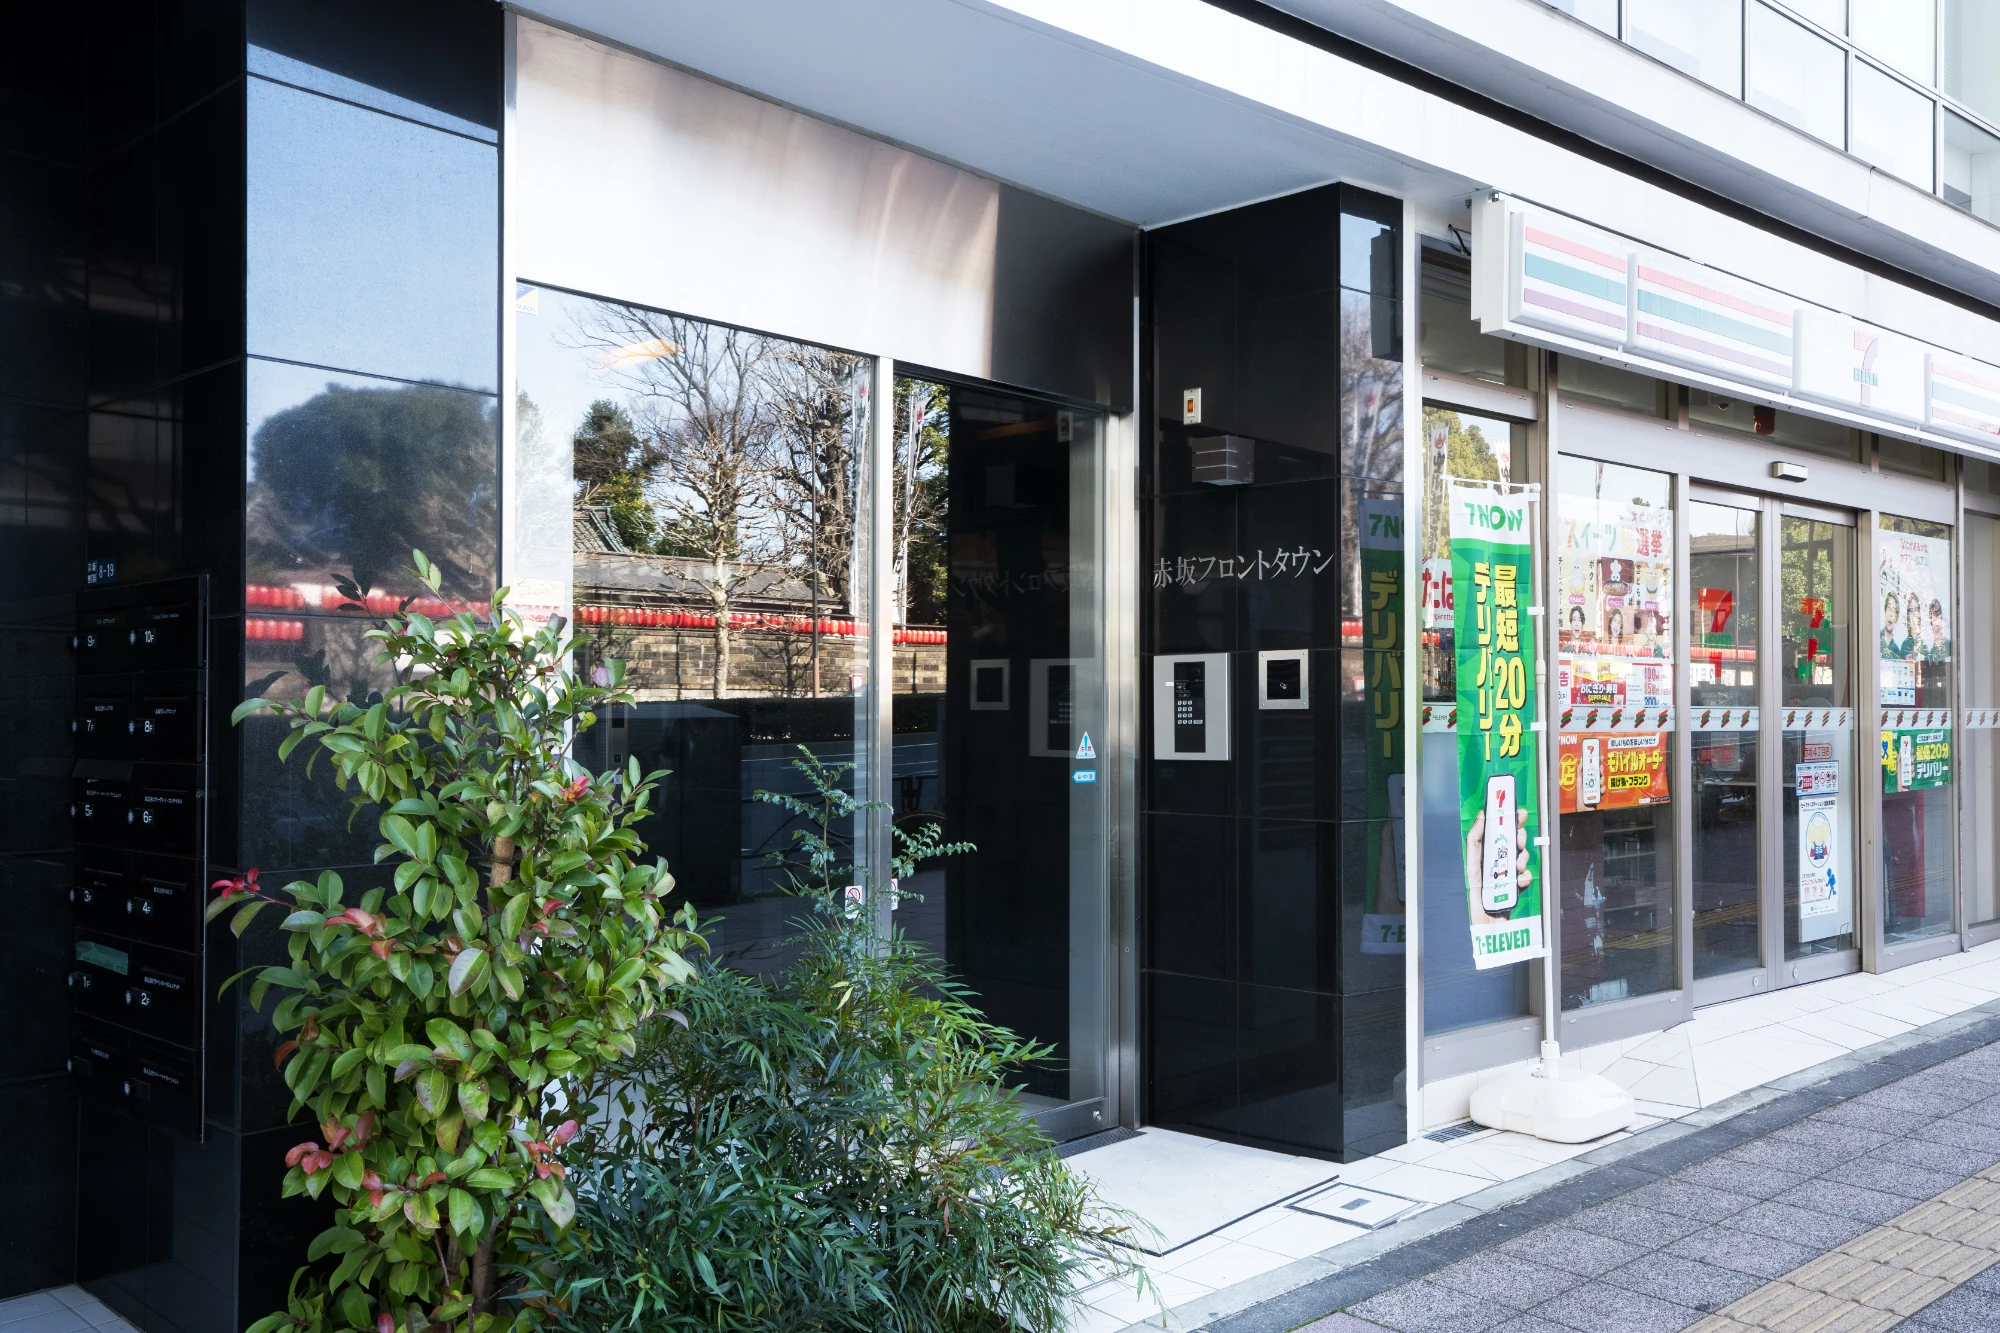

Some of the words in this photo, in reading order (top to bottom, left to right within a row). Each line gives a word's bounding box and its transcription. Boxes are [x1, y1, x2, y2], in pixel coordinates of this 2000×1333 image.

[1464, 501, 1522, 531] 7NOW
[98, 563, 114, 579] 8-19
[1153, 546, 1334, 588] 赤坂フロントタウン
[144, 630, 154, 643] 10F
[1370, 571, 1402, 758] デリバリー
[1474, 561, 1493, 761] デリバリー
[1494, 565, 1526, 757] 最短20分
[86, 720, 94, 732] 7F
[144, 720, 153, 733] 8F
[1559, 735, 1578, 745] NOW
[1608, 749, 1663, 773] モバイルオーダー
[1916, 761, 1949, 779] デリバリー
[84, 804, 93, 816] 5F
[142, 811, 152, 823] 6F
[83, 890, 92, 902] 3F
[142, 901, 151, 914] 4F
[82, 976, 91, 988] 1F
[141, 992, 150, 1006] 2F
